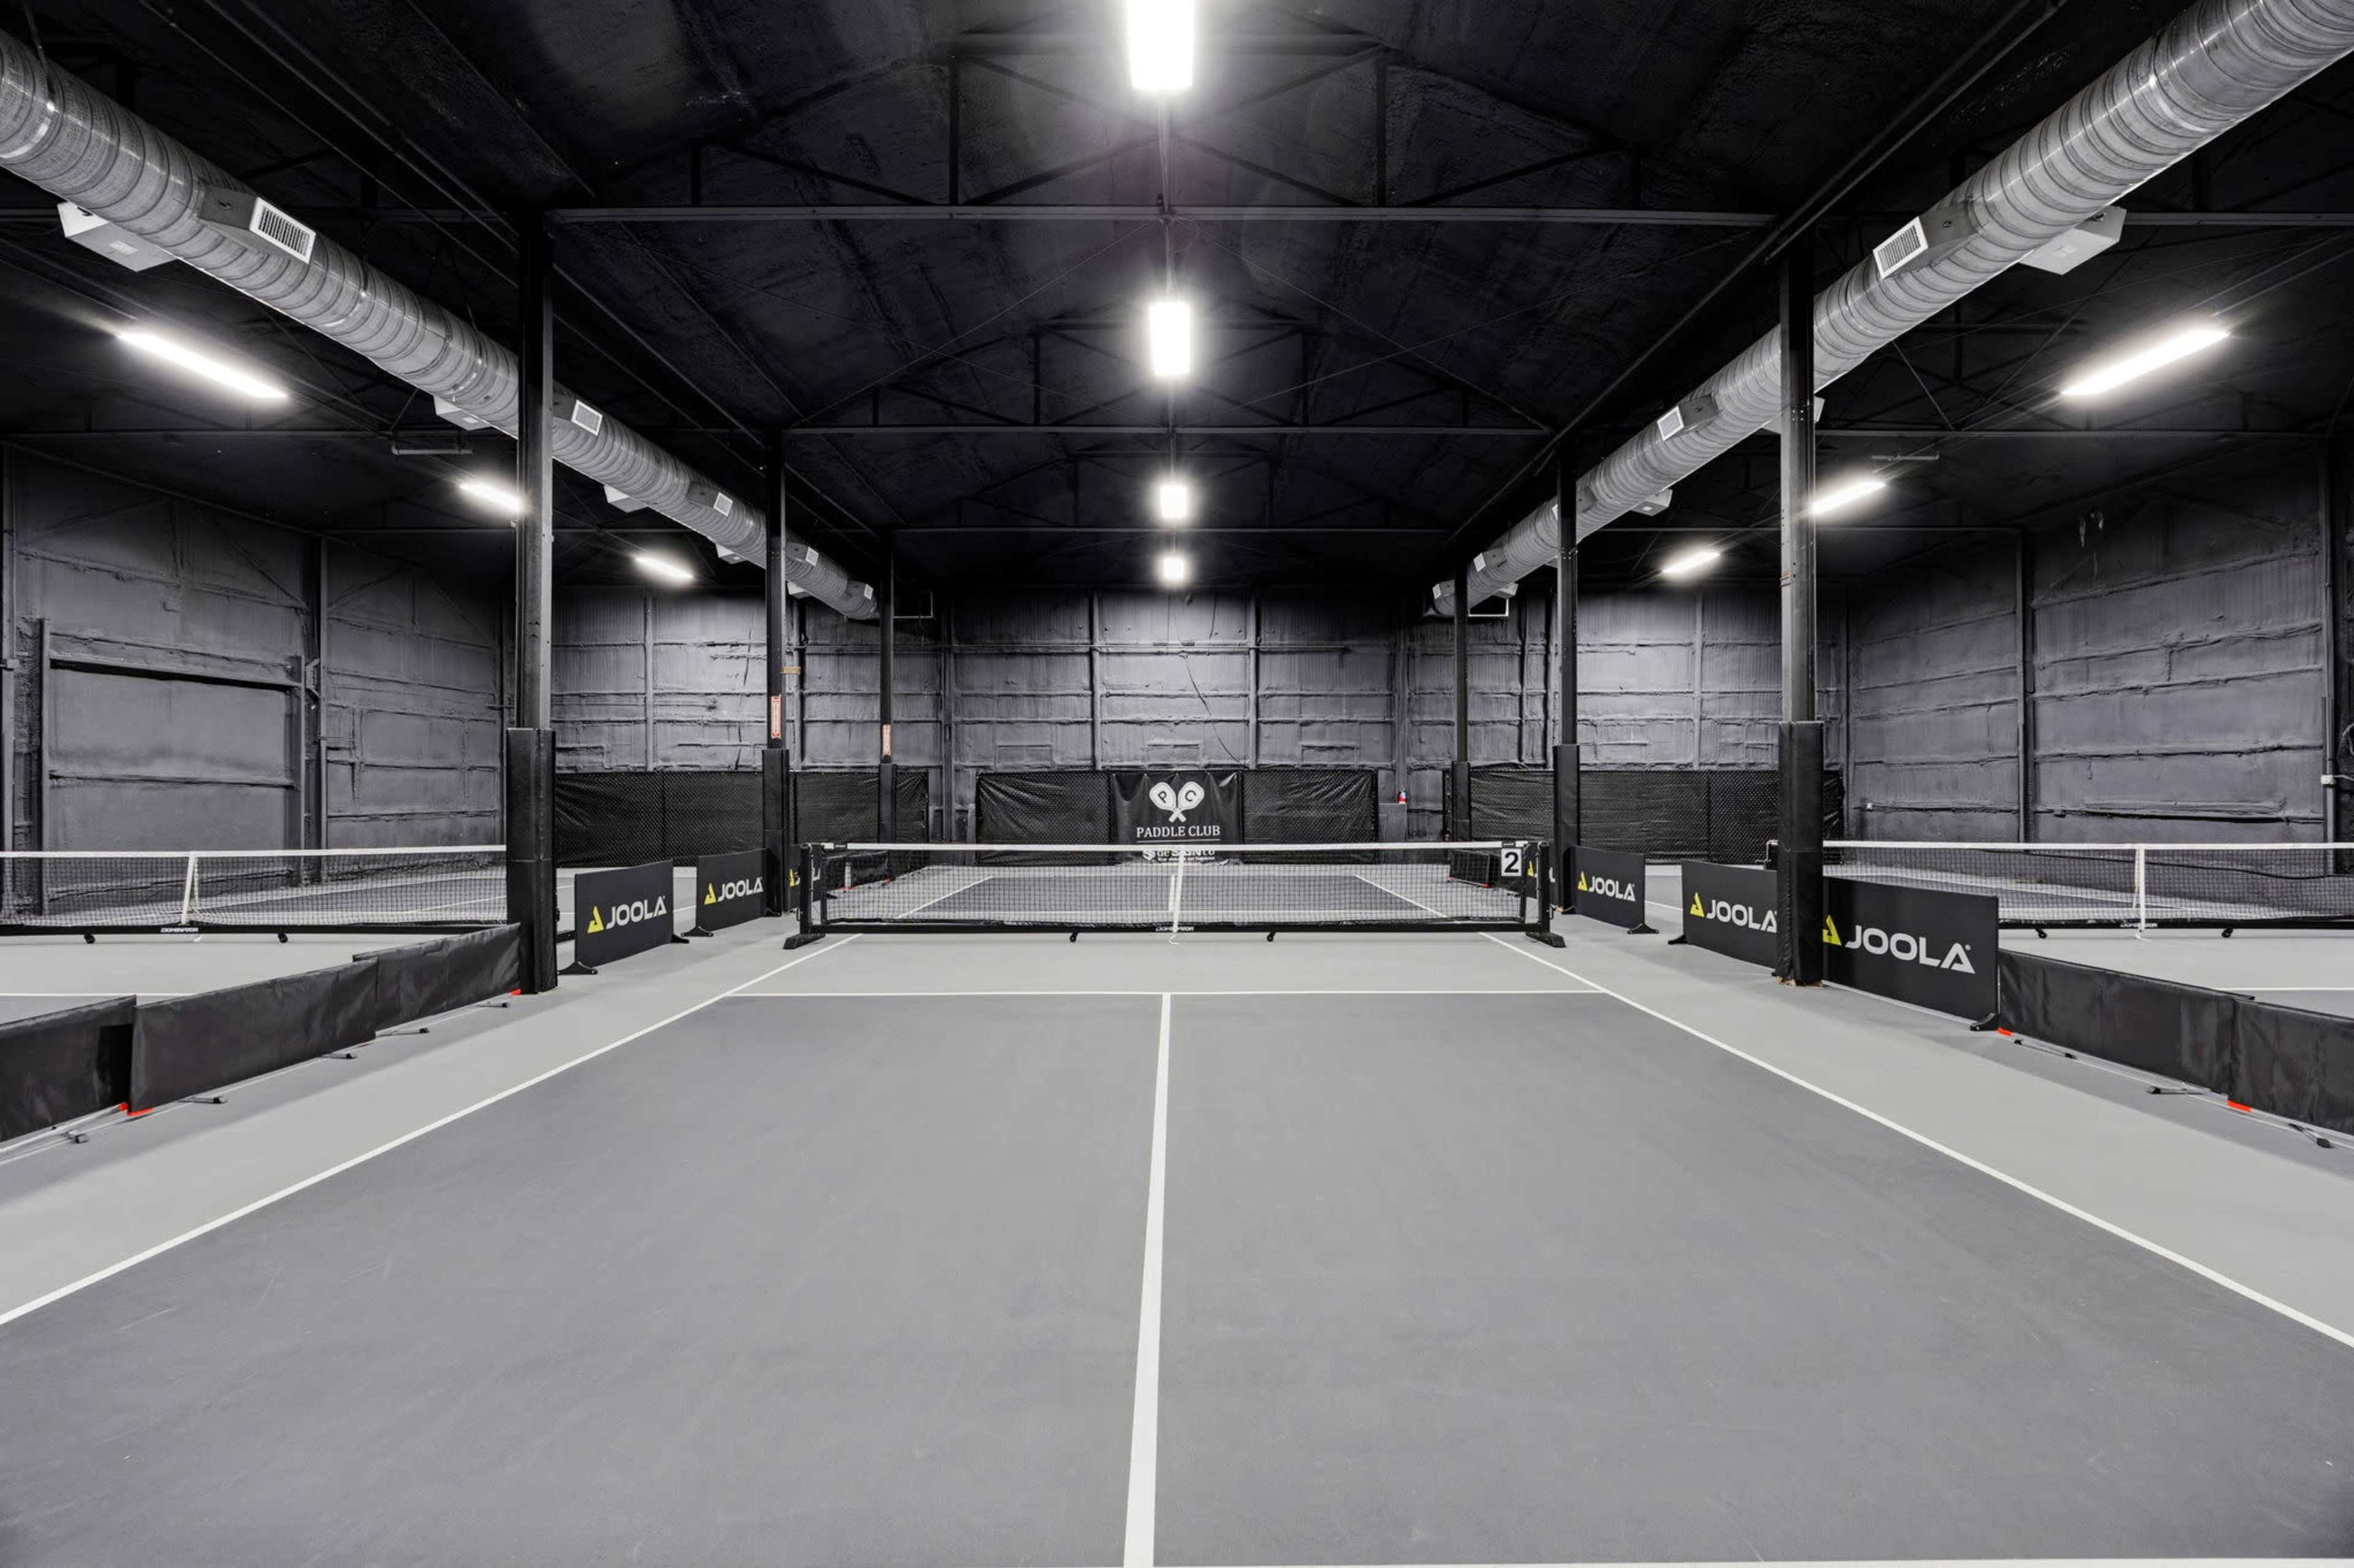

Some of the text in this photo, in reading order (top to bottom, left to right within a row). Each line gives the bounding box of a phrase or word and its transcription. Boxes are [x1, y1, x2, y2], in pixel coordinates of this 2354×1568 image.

[1157, 790, 1196, 804] P C
[1136, 826, 1221, 838] PADDLE CLUB
[1504, 851, 1519, 873] 2
[717, 877, 763, 902] JOOLA
[1588, 876, 1636, 902] JOOLA
[606, 896, 667, 930] JOOLA
[1706, 899, 1777, 934] JOOLA
[1845, 924, 1976, 974] JOOLA
